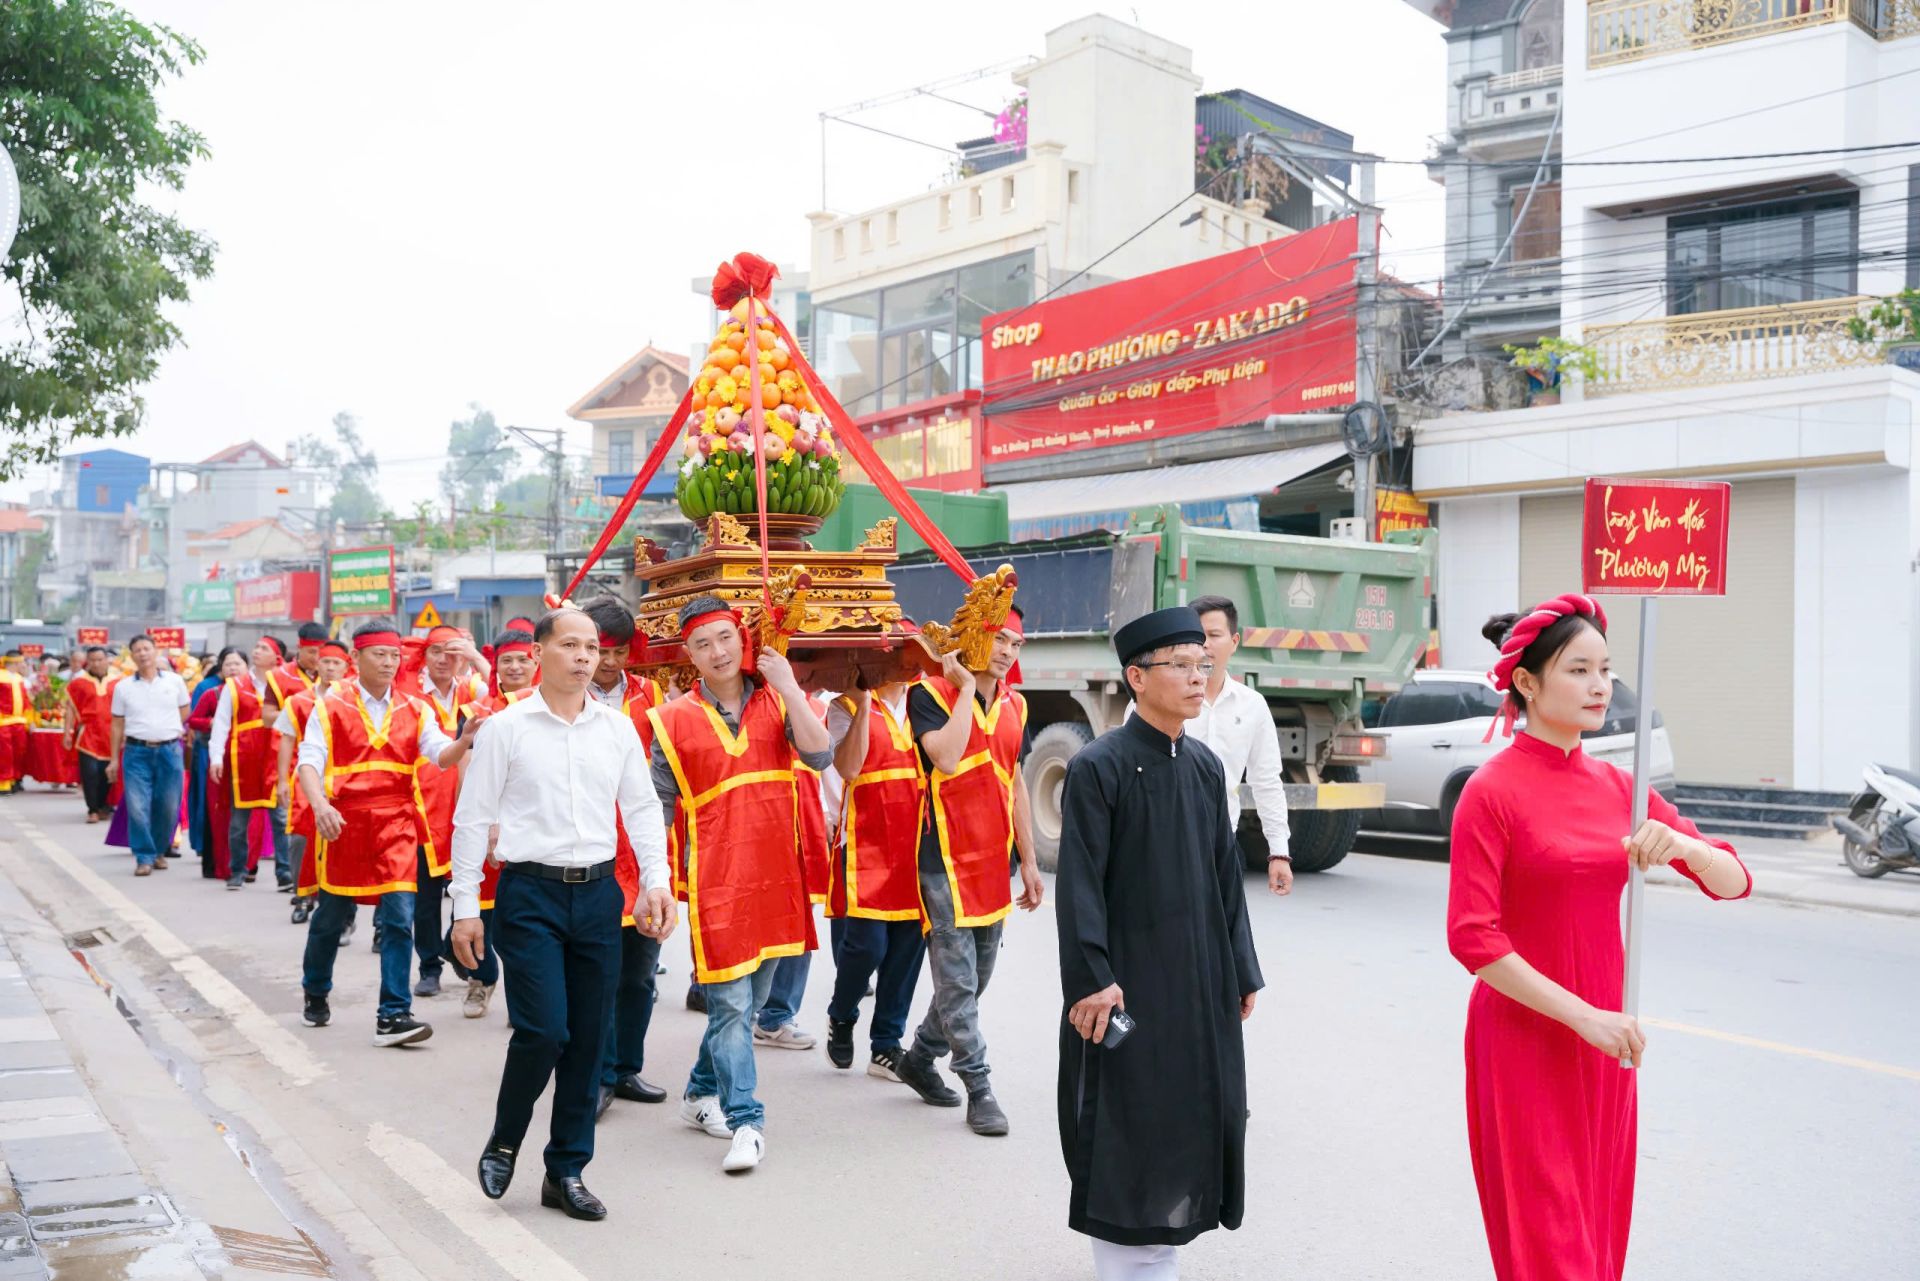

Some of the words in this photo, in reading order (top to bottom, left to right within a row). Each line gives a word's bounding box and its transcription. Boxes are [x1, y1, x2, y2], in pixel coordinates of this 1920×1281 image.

[991, 321, 1042, 350] Shop
[1085, 329, 1181, 372] PHƯƠNG
[1193, 296, 1310, 350] ZAKADO
[1232, 356, 1267, 381] kiện
[1642, 496, 1672, 533] Văn
[1594, 547, 1669, 593] Phương
[1676, 551, 1711, 592] Mỹ
[1364, 584, 1388, 607] 15H
